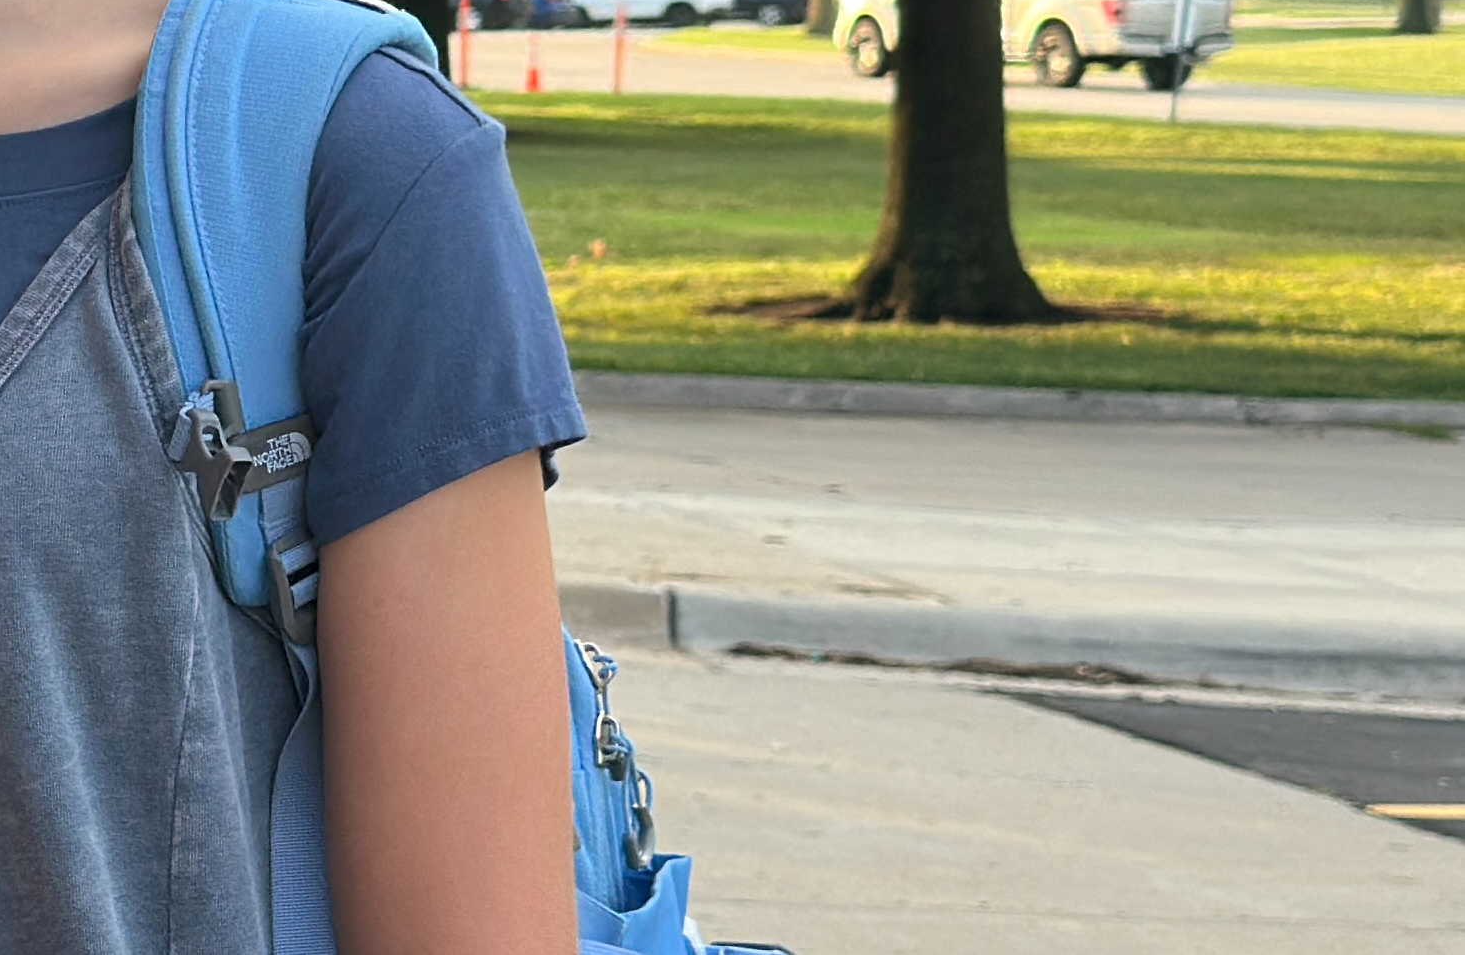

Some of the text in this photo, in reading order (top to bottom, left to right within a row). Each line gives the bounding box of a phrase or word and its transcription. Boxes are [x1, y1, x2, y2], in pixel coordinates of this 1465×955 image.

[266, 434, 290, 449] THE
[253, 447, 291, 466] NORTH
[267, 455, 294, 473] FACE
